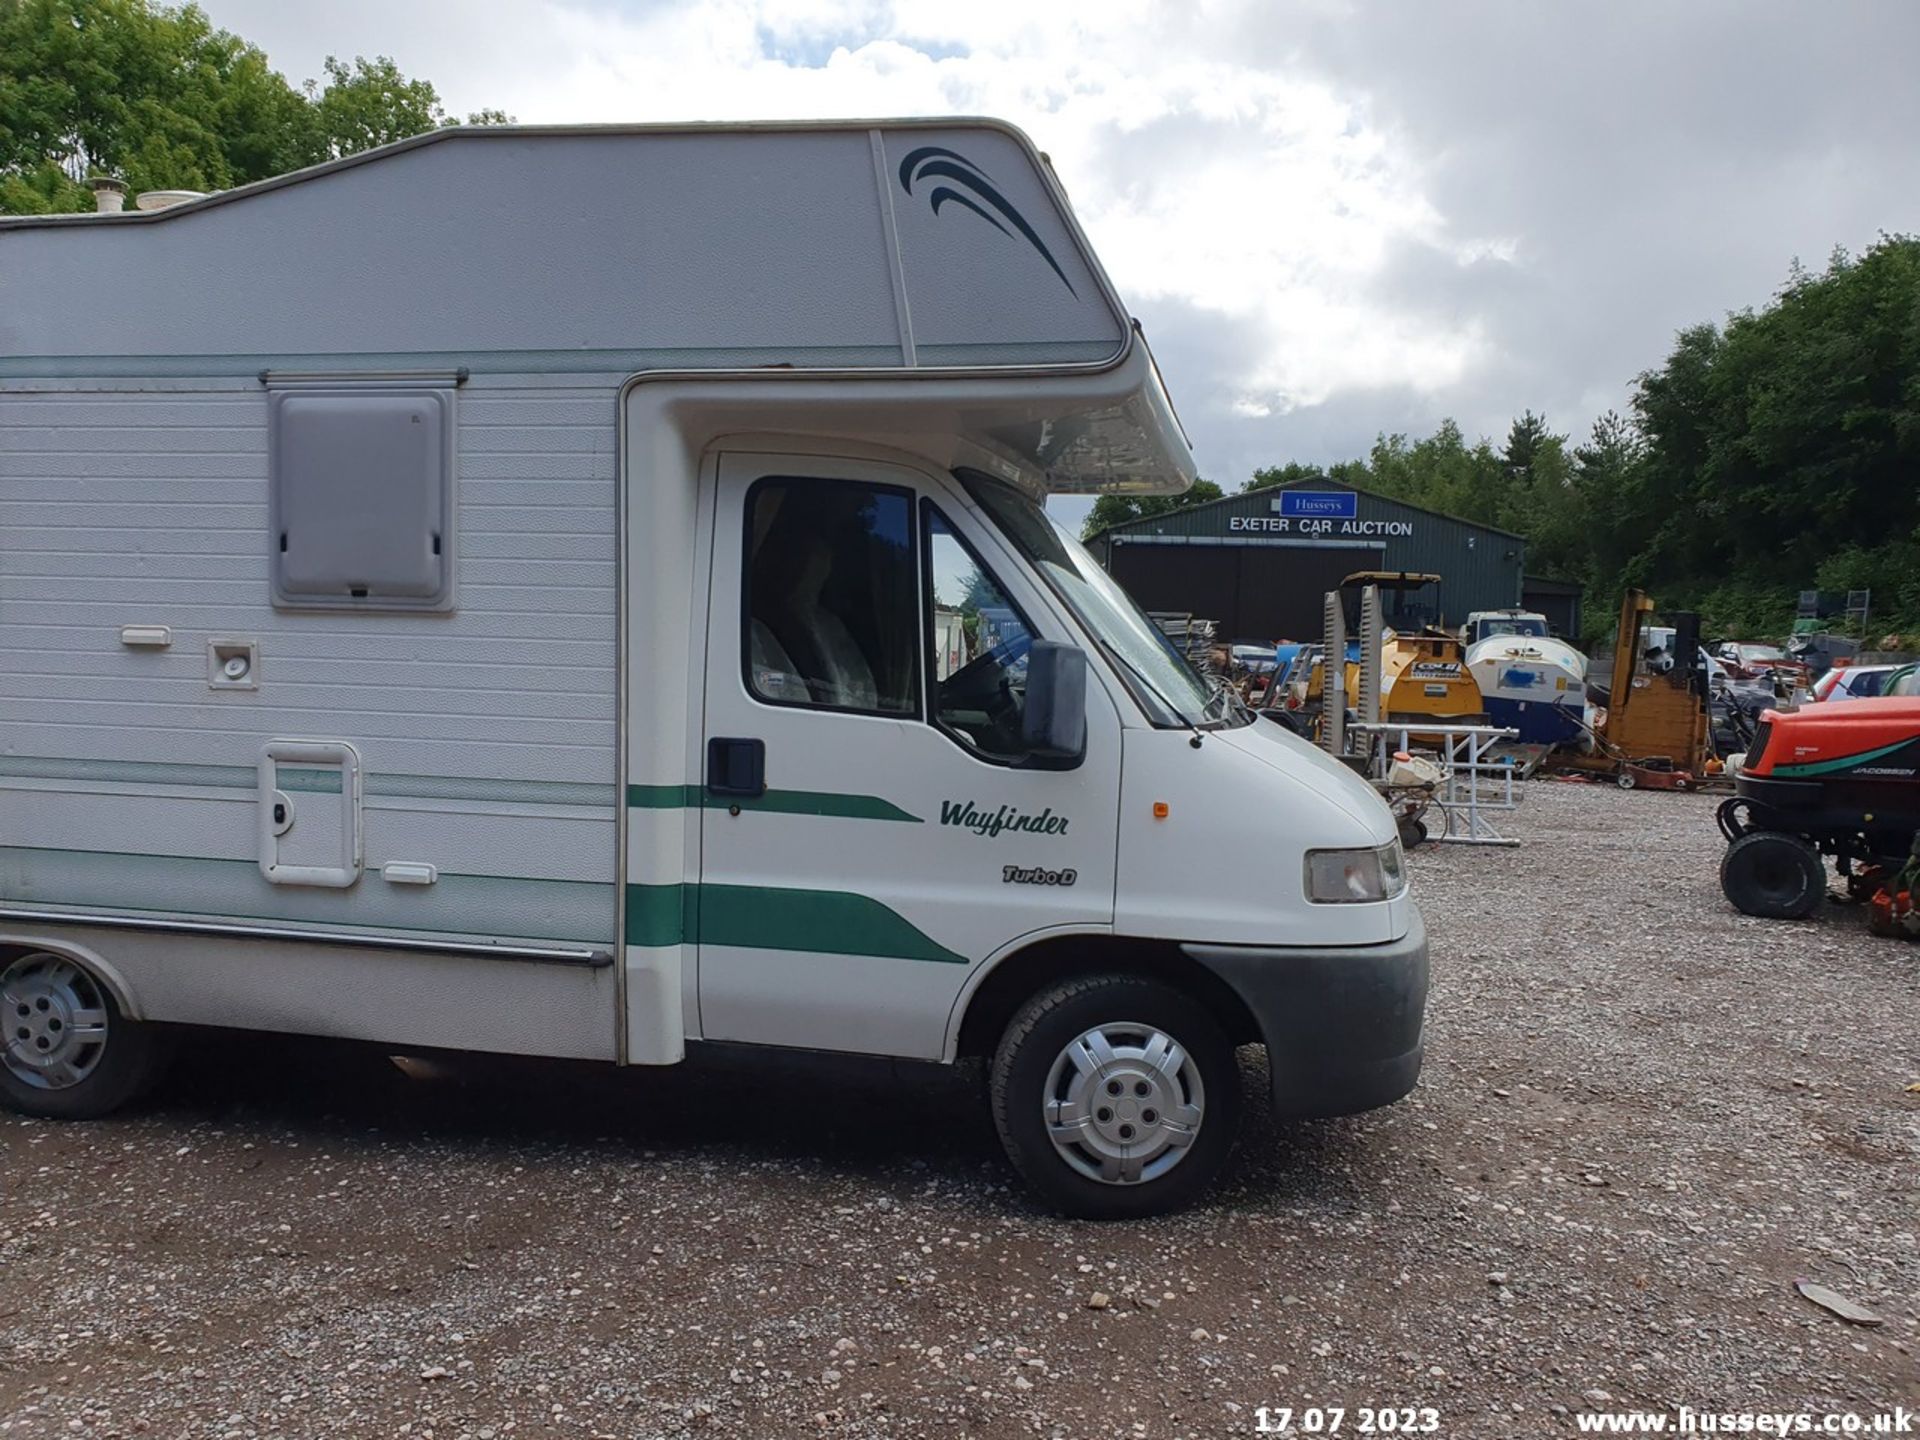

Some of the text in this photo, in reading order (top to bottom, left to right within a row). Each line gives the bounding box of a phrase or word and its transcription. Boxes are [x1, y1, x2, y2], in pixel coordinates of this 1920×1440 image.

[1295, 498, 1342, 512] Husseys
[1229, 517, 1412, 535] EXETER CAR AUCTION
[940, 800, 1070, 837] Wayfinder
